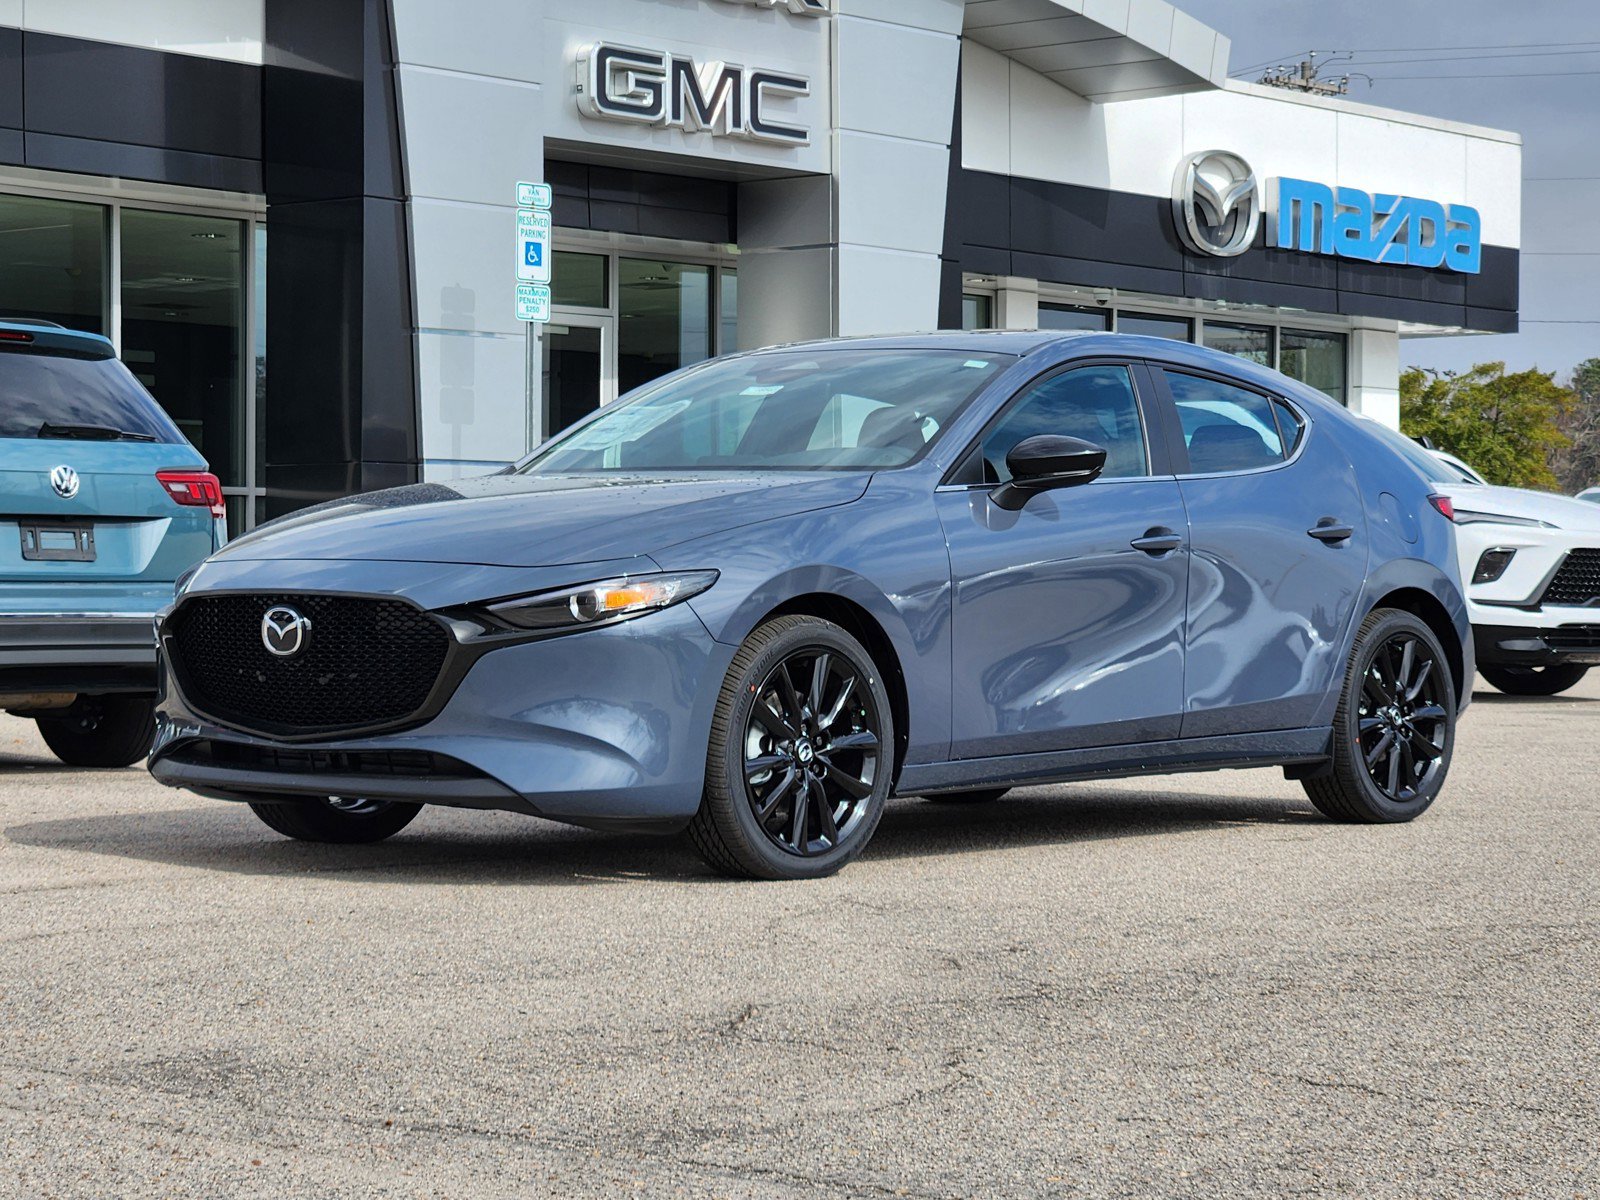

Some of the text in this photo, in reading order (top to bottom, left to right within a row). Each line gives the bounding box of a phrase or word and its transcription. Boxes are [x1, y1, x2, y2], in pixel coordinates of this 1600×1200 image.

[577, 40, 811, 147] GMC
[527, 187, 540, 196] VAN
[518, 215, 549, 228] RESERVED
[520, 228, 547, 240] PARKING
[518, 288, 548, 298] MAXIMUM
[518, 296, 547, 305] PENALTY
[525, 304, 540, 314] $250
